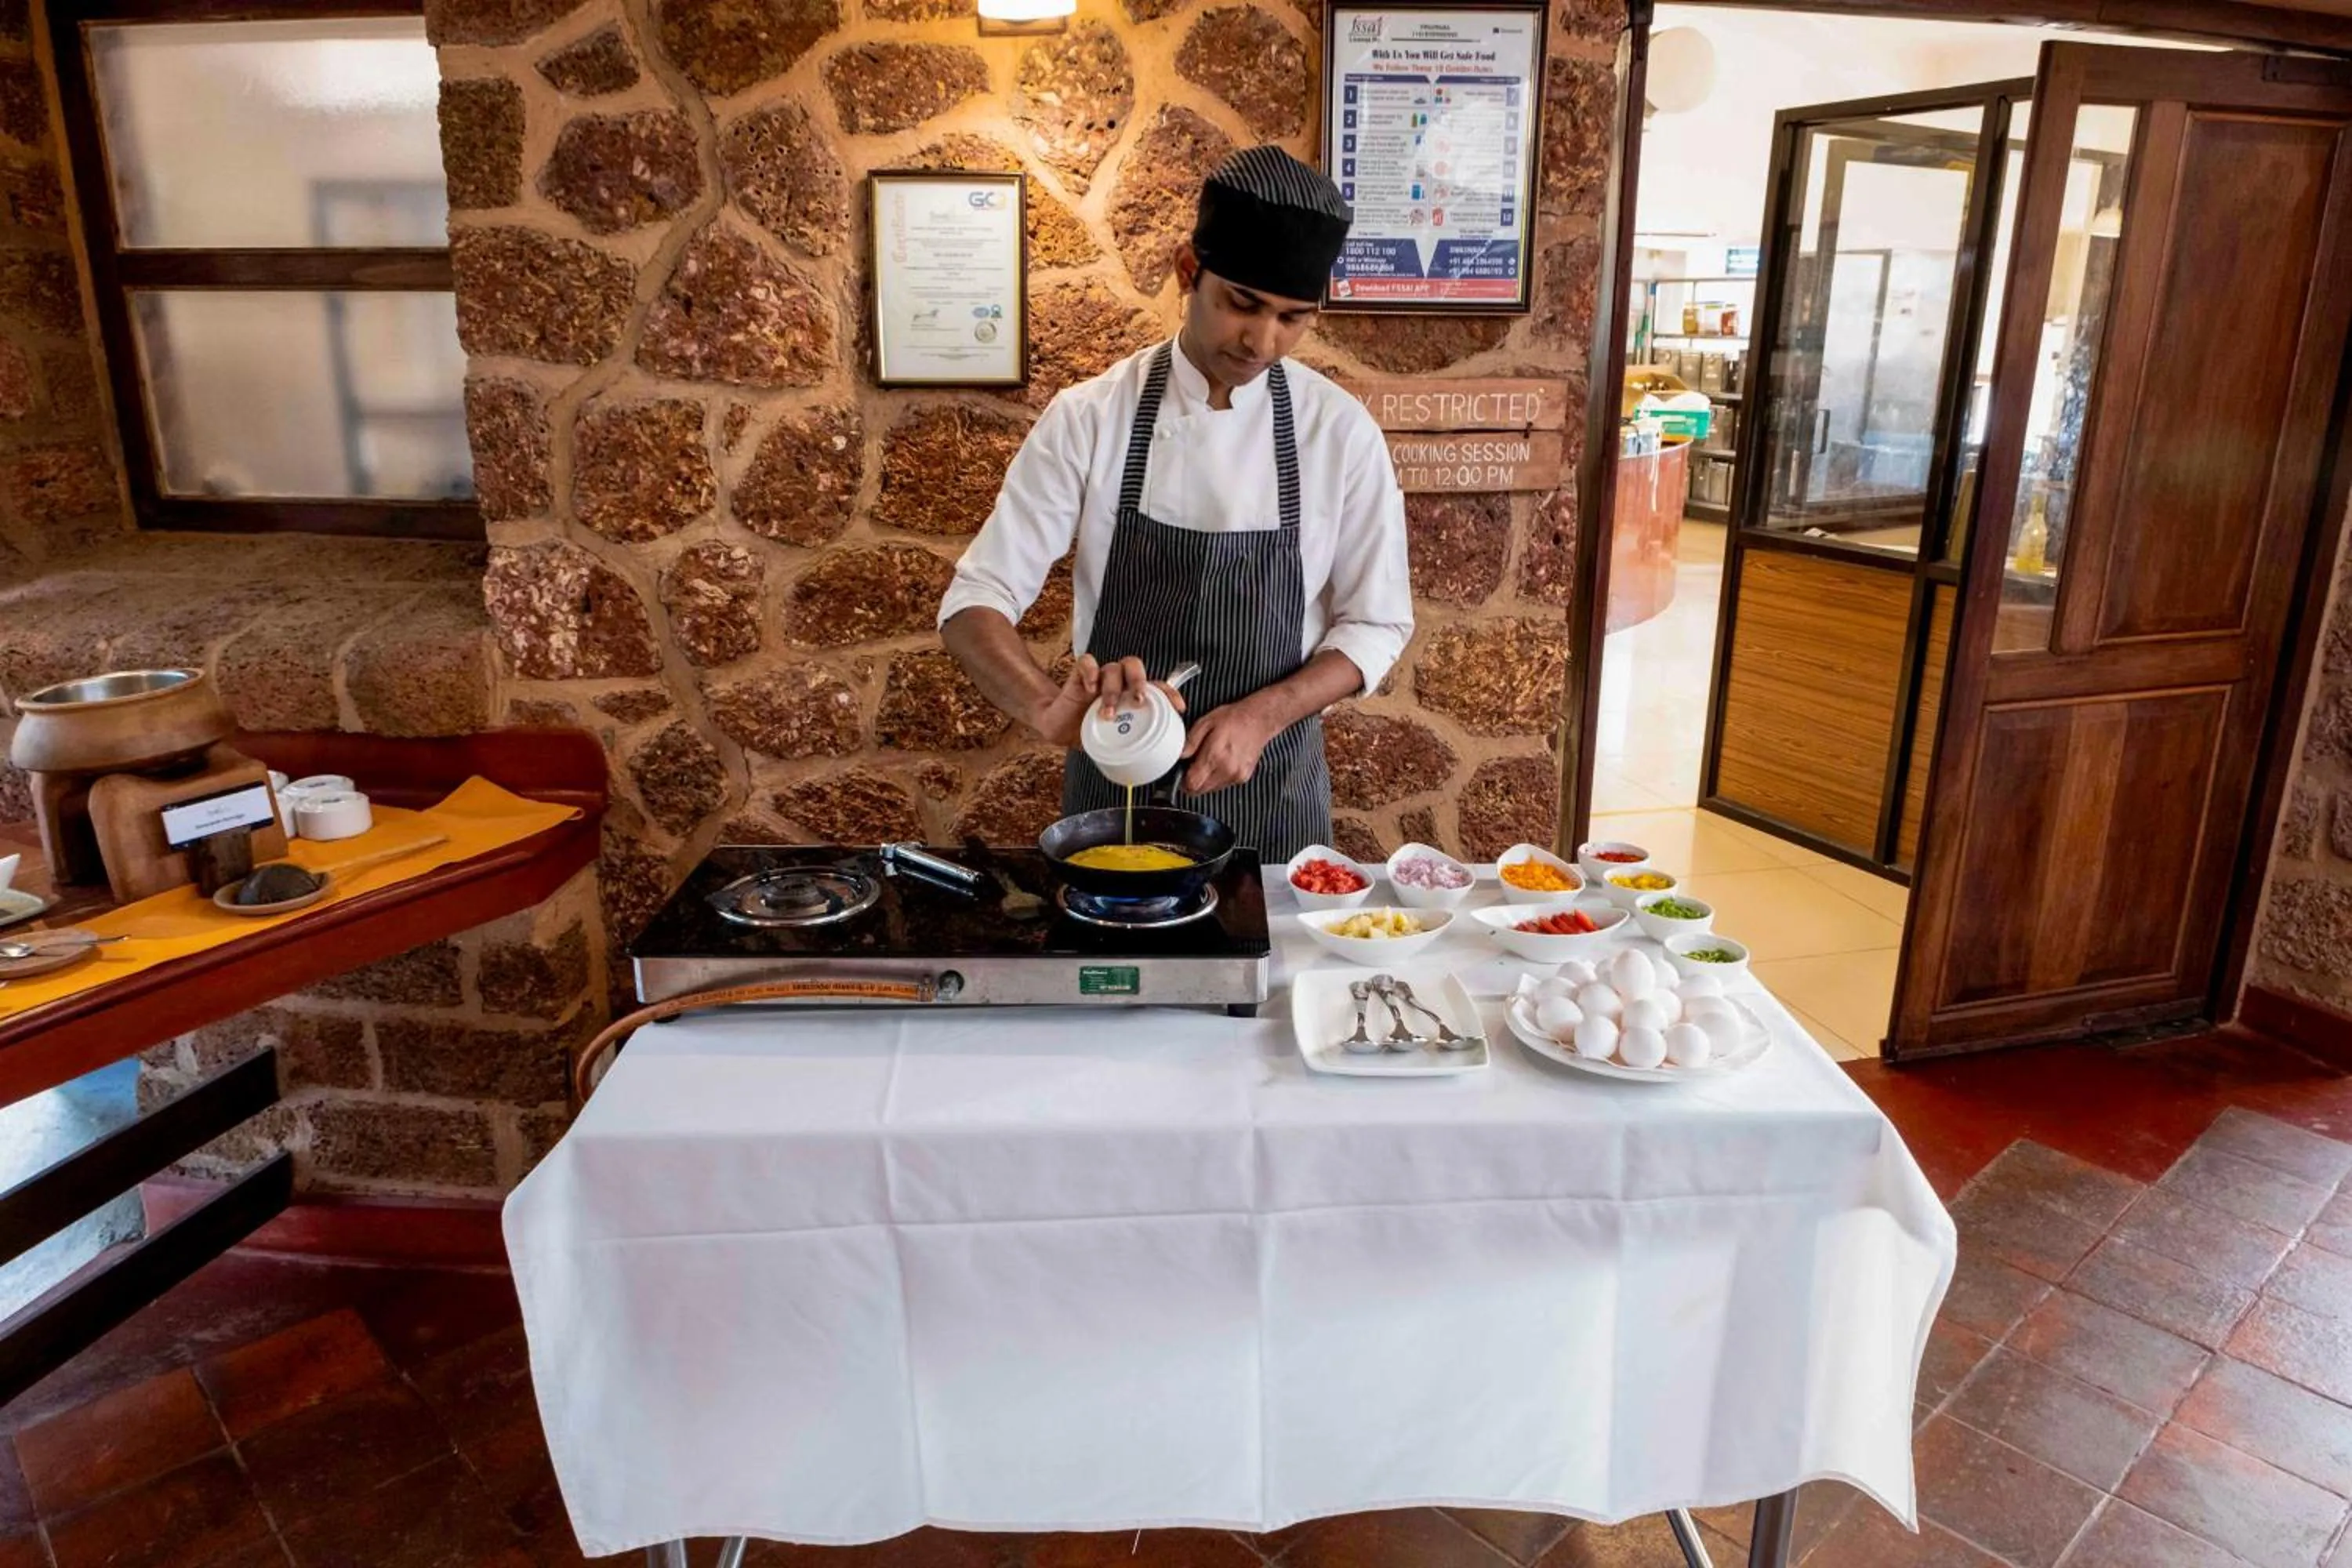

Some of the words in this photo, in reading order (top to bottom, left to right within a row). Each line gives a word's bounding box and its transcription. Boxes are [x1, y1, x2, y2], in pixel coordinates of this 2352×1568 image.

[1372, 49, 1390, 59] With
[1404, 49, 1421, 60] You
[1422, 49, 1439, 60] Will
[1440, 50, 1454, 60] Get
[1382, 393, 1541, 422] RESTRICTED
[1392, 442, 1457, 464] COOKING
[1461, 441, 1530, 463] SESSION
[1407, 468, 1428, 485] TO
[1436, 466, 1482, 486] 12:00
[1487, 466, 1513, 484] PM
